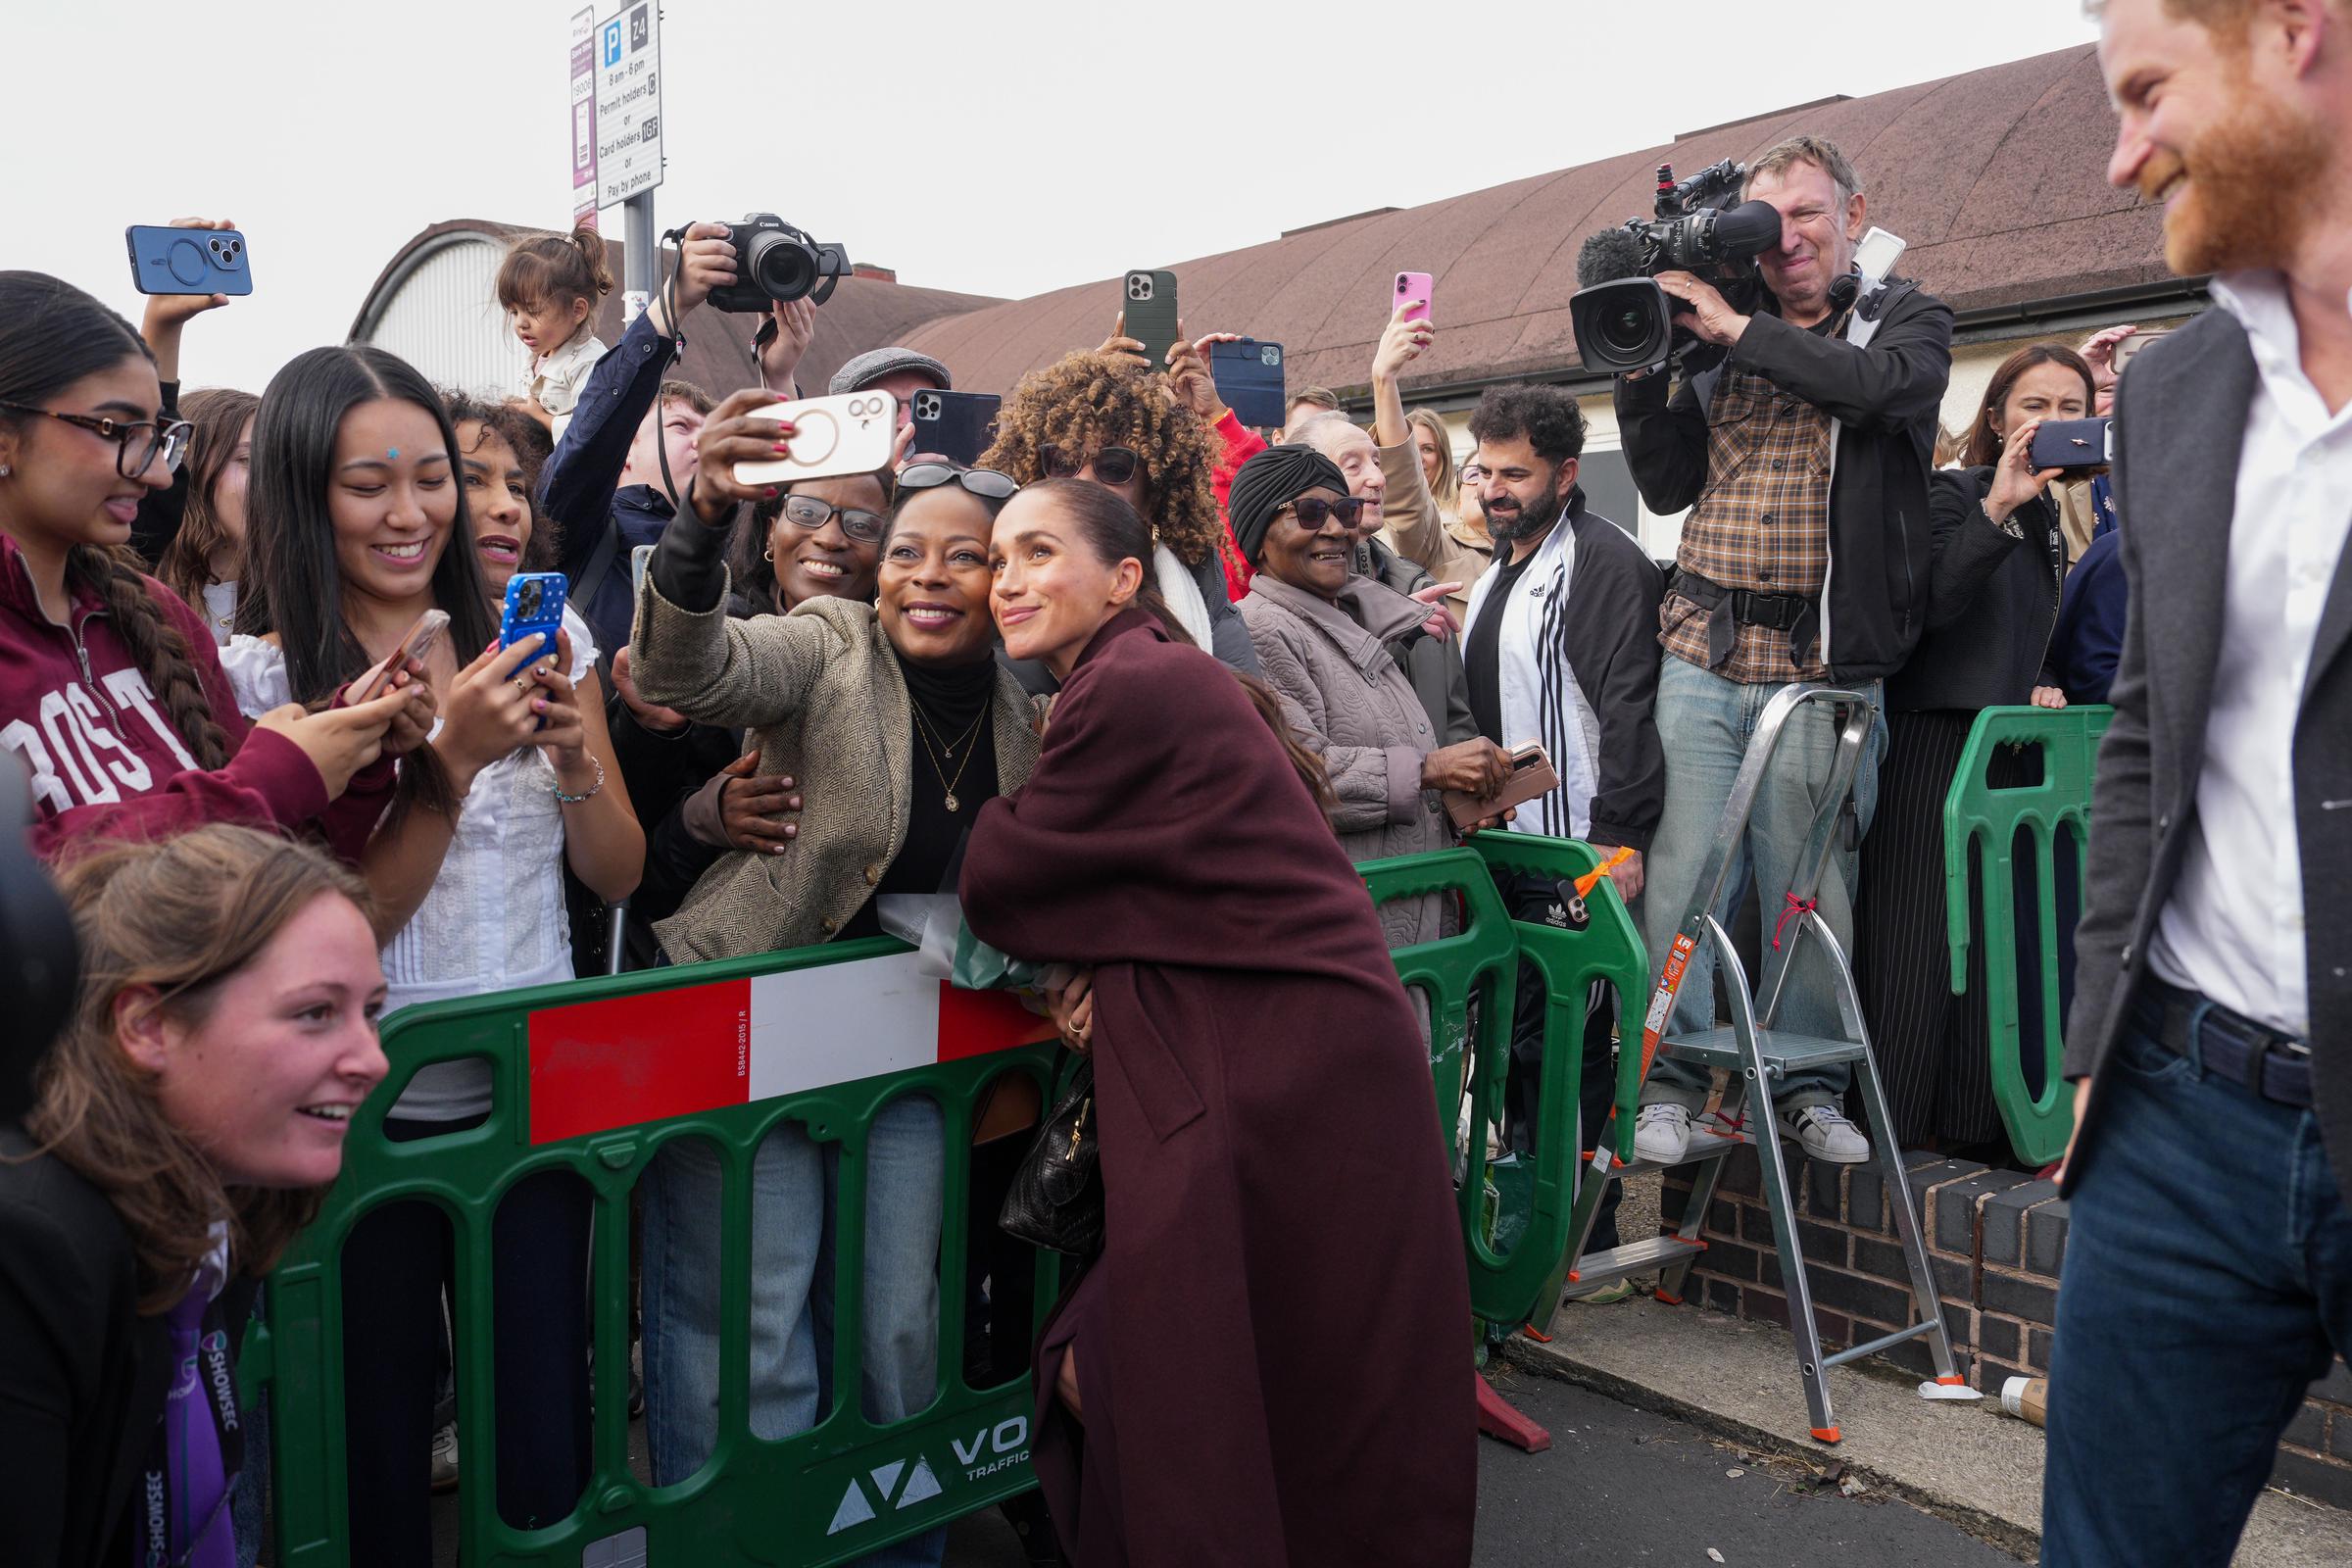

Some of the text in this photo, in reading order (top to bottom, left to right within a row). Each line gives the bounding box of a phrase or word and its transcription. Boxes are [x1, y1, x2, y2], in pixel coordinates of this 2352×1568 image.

[632, 17, 646, 42] Z4
[608, 27, 618, 64] P
[609, 74, 613, 86] 8
[614, 71, 624, 84] am
[628, 63, 634, 75] 6
[634, 60, 645, 75] pm
[600, 75, 656, 118] Permit holders C
[624, 114, 631, 126] or
[600, 119, 658, 159] Card holders 1GF
[625, 157, 632, 169] or
[608, 183, 619, 198] Pay
[620, 179, 628, 193] by
[630, 171, 652, 191] phone
[1359, 547, 1370, 575] BOSS
[1545, 916, 1567, 927] adidas
[208, 1351, 238, 1432] SHOWSEC
[951, 1415, 1028, 1466] VO
[965, 1450, 1030, 1482] TRAFFIC
[146, 1471, 166, 1550] SHOWSEC
